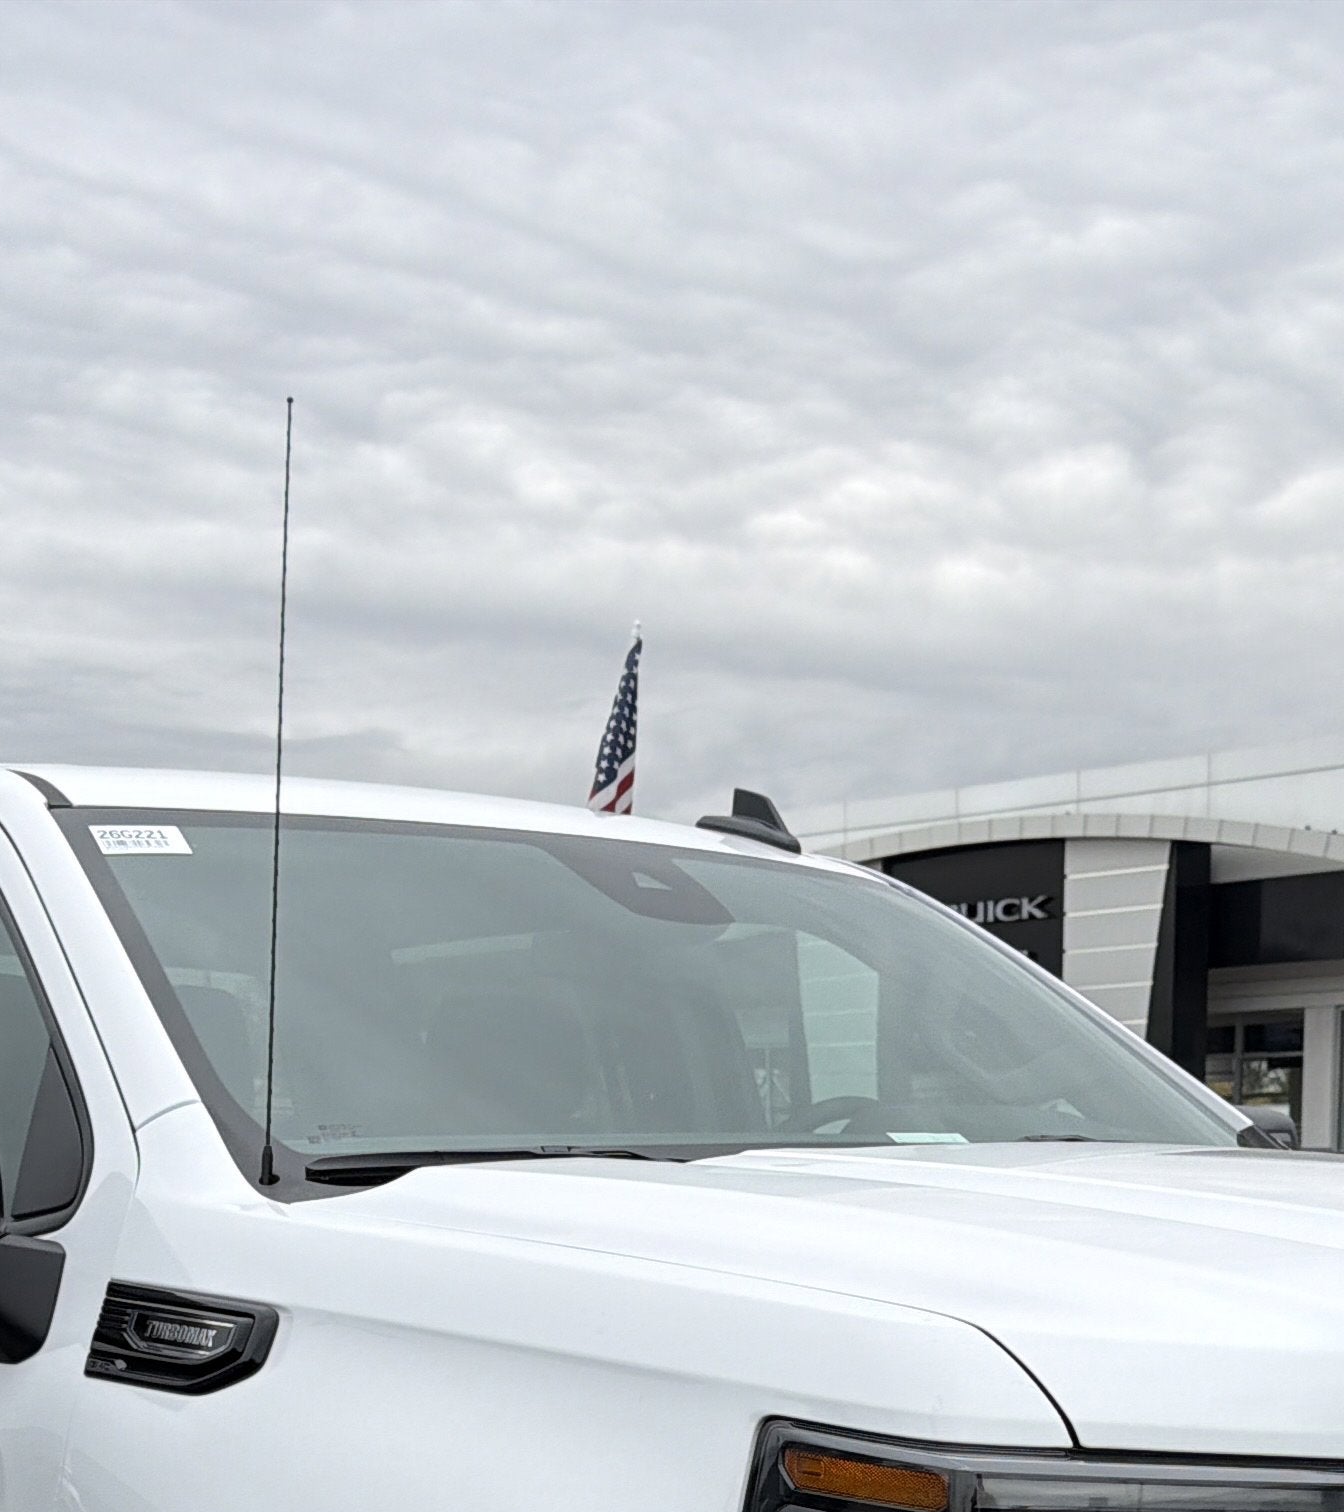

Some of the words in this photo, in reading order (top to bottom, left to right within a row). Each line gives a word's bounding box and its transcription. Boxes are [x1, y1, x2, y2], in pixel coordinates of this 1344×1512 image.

[96, 829, 169, 840] 26G221
[947, 894, 1050, 924] UICK
[144, 1319, 219, 1348] TURBOMAX
